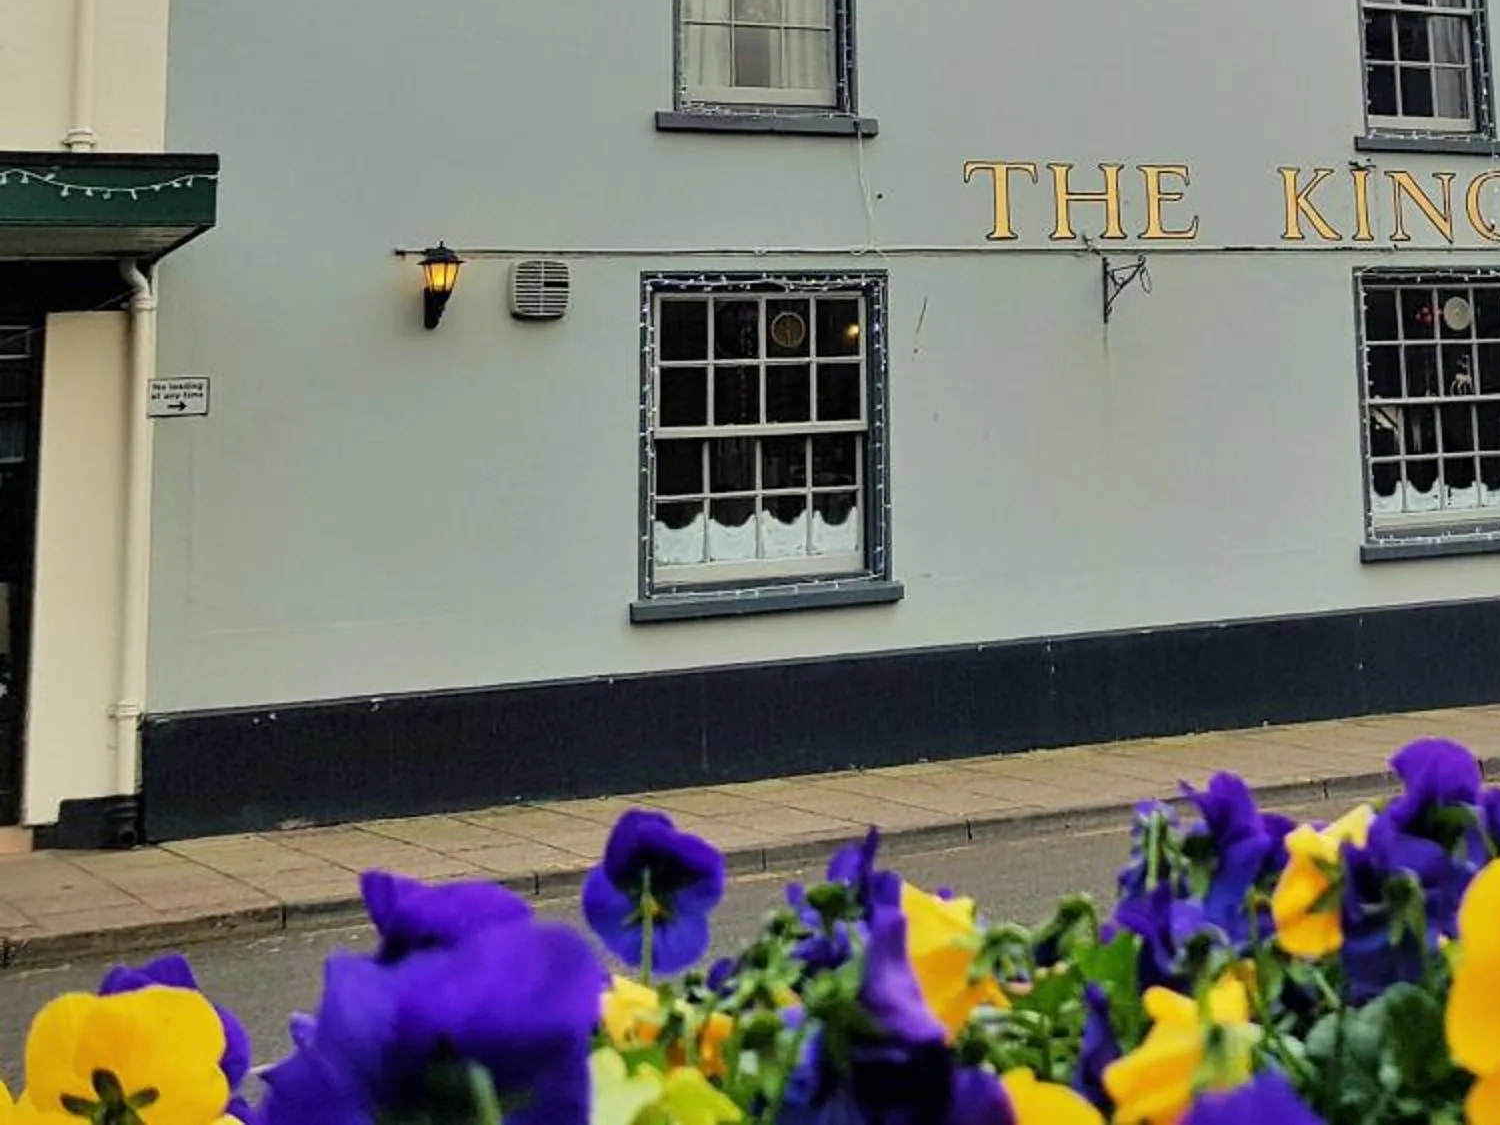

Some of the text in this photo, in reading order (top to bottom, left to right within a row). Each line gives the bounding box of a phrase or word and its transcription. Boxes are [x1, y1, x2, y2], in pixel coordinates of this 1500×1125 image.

[963, 160, 1199, 240] THE
[169, 382, 203, 391] loading
[151, 391, 204, 401] at any time
